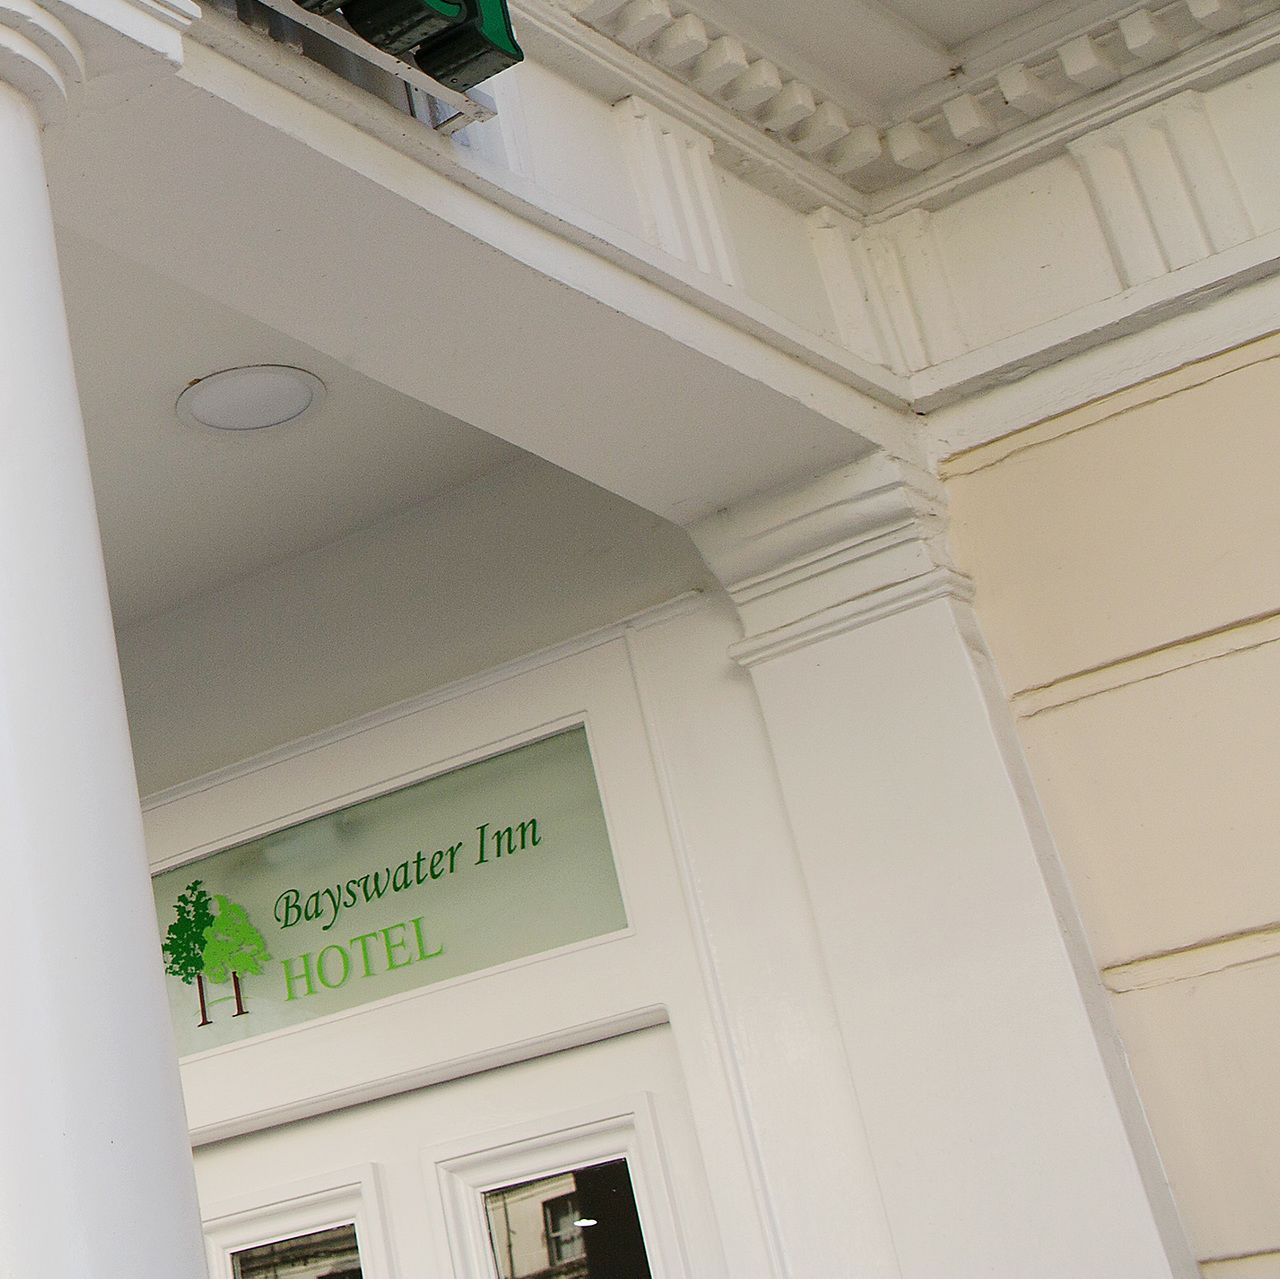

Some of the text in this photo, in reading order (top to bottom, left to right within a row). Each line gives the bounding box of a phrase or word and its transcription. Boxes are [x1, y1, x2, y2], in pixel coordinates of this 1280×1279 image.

[273, 816, 542, 932] Bayswater Inn
[281, 916, 445, 1003] HOTEL
